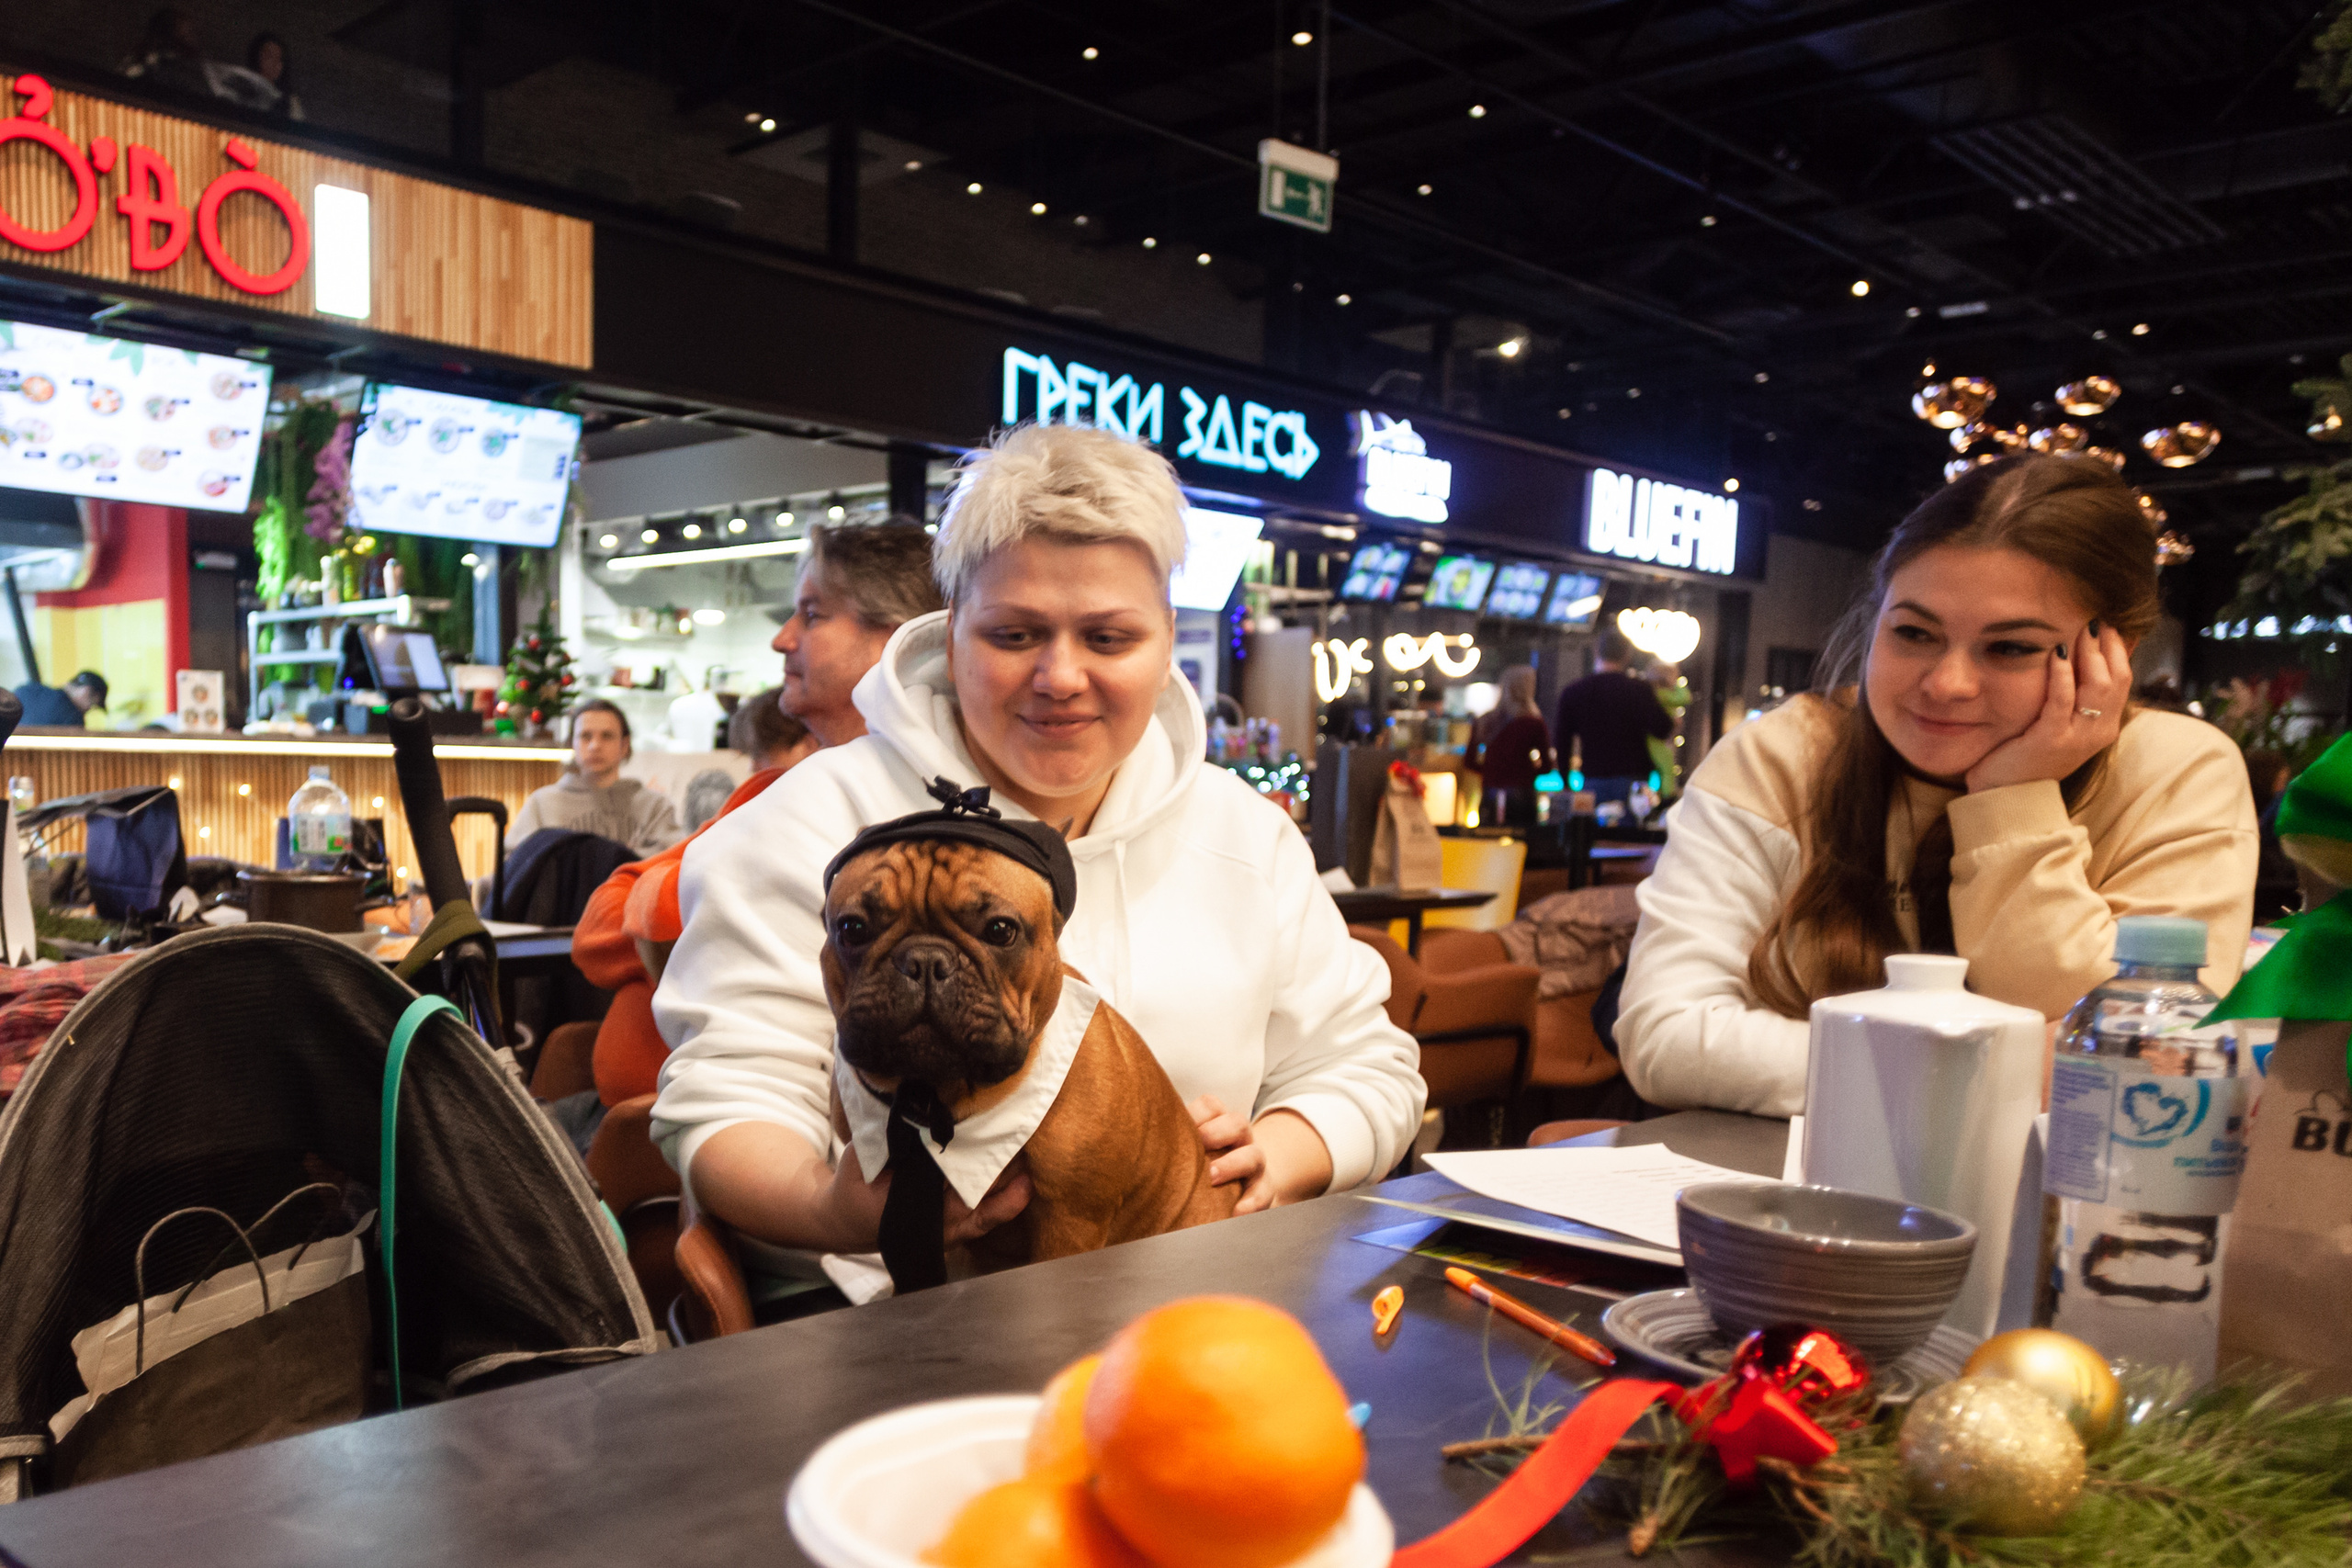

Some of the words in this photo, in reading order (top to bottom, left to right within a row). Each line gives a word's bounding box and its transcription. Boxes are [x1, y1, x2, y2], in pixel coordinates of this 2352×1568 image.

[1003, 346, 1164, 444] ГРЕКИ
[1177, 386, 1320, 480] ЗДЕСЬ
[1588, 468, 1739, 575] BLUEFIN
